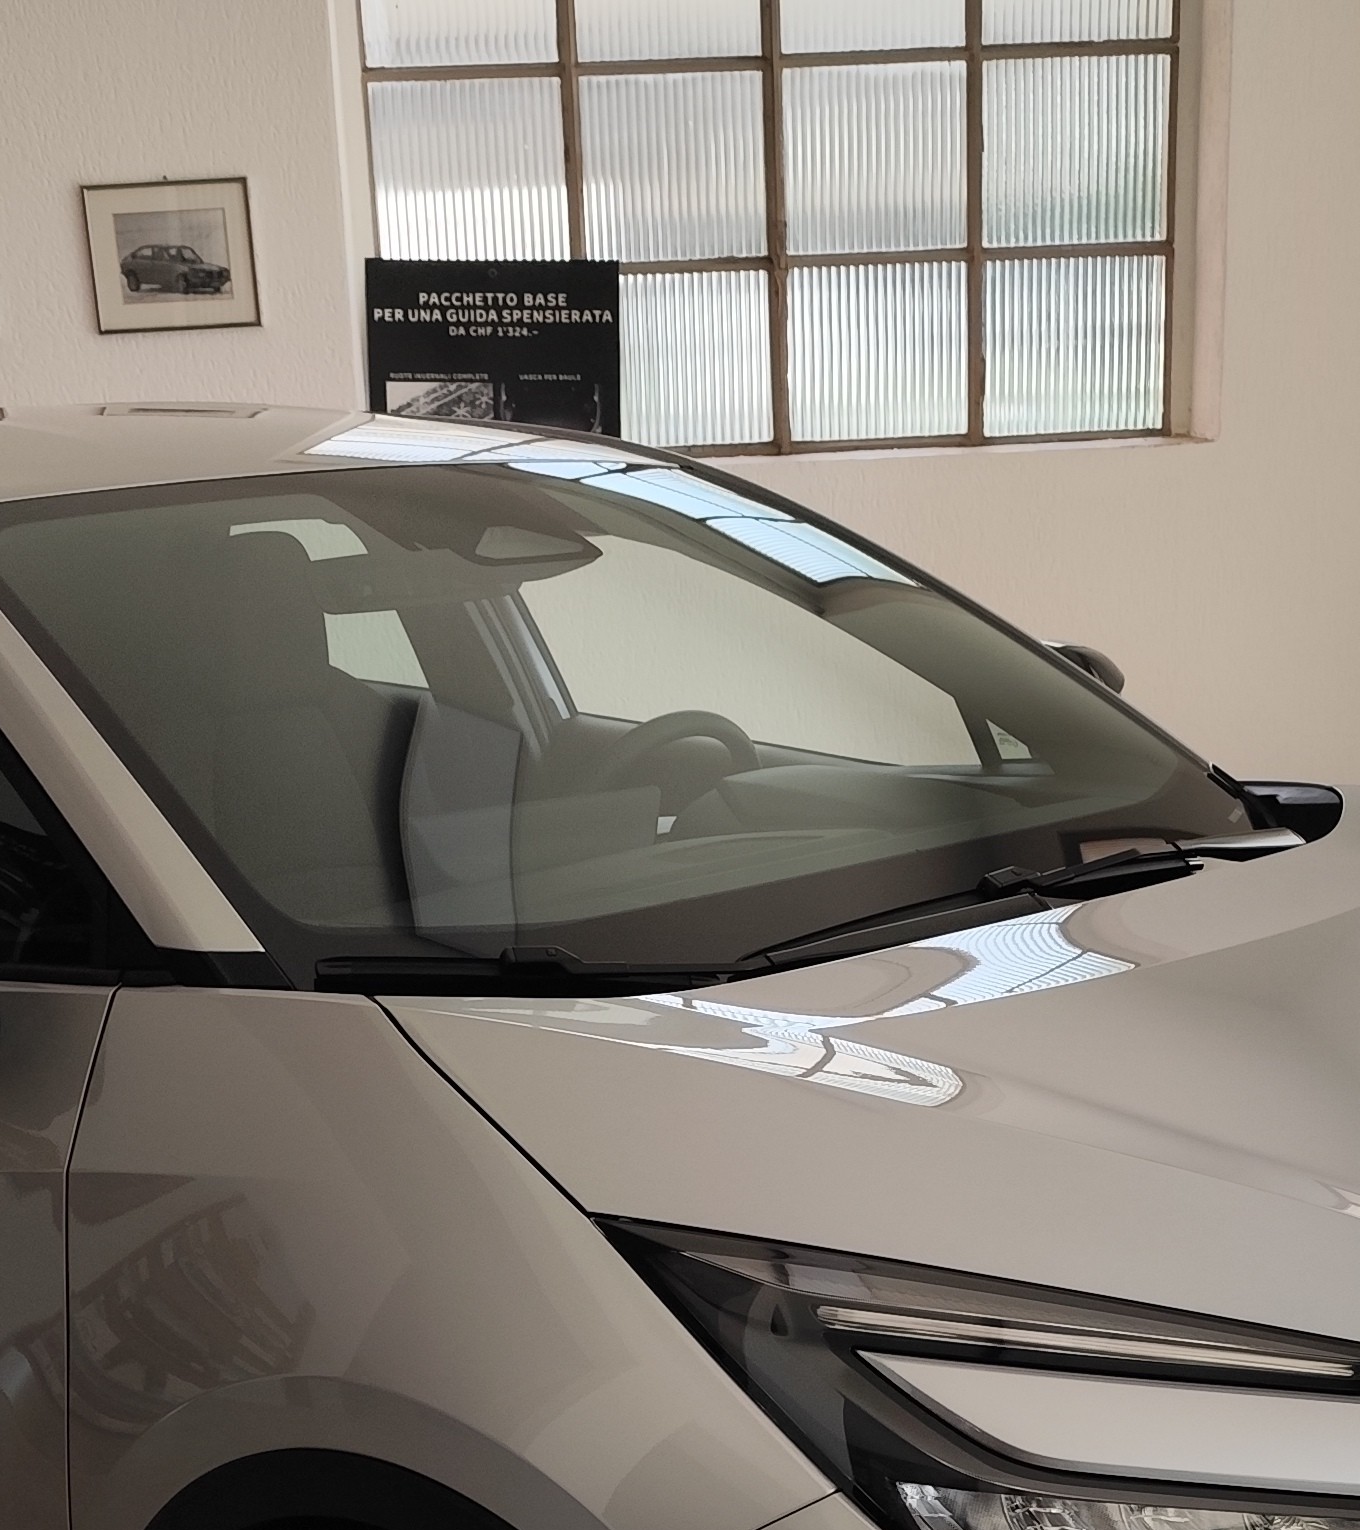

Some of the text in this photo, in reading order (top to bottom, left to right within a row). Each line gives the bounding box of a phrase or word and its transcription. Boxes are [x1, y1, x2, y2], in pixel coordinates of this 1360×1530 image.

[418, 292, 568, 307] PACCHETTO BASE
[373, 308, 614, 324] PER UNA GUIDA SPENSIERATA
[448, 325, 466, 337] DA
[469, 325, 494, 337] CHF
